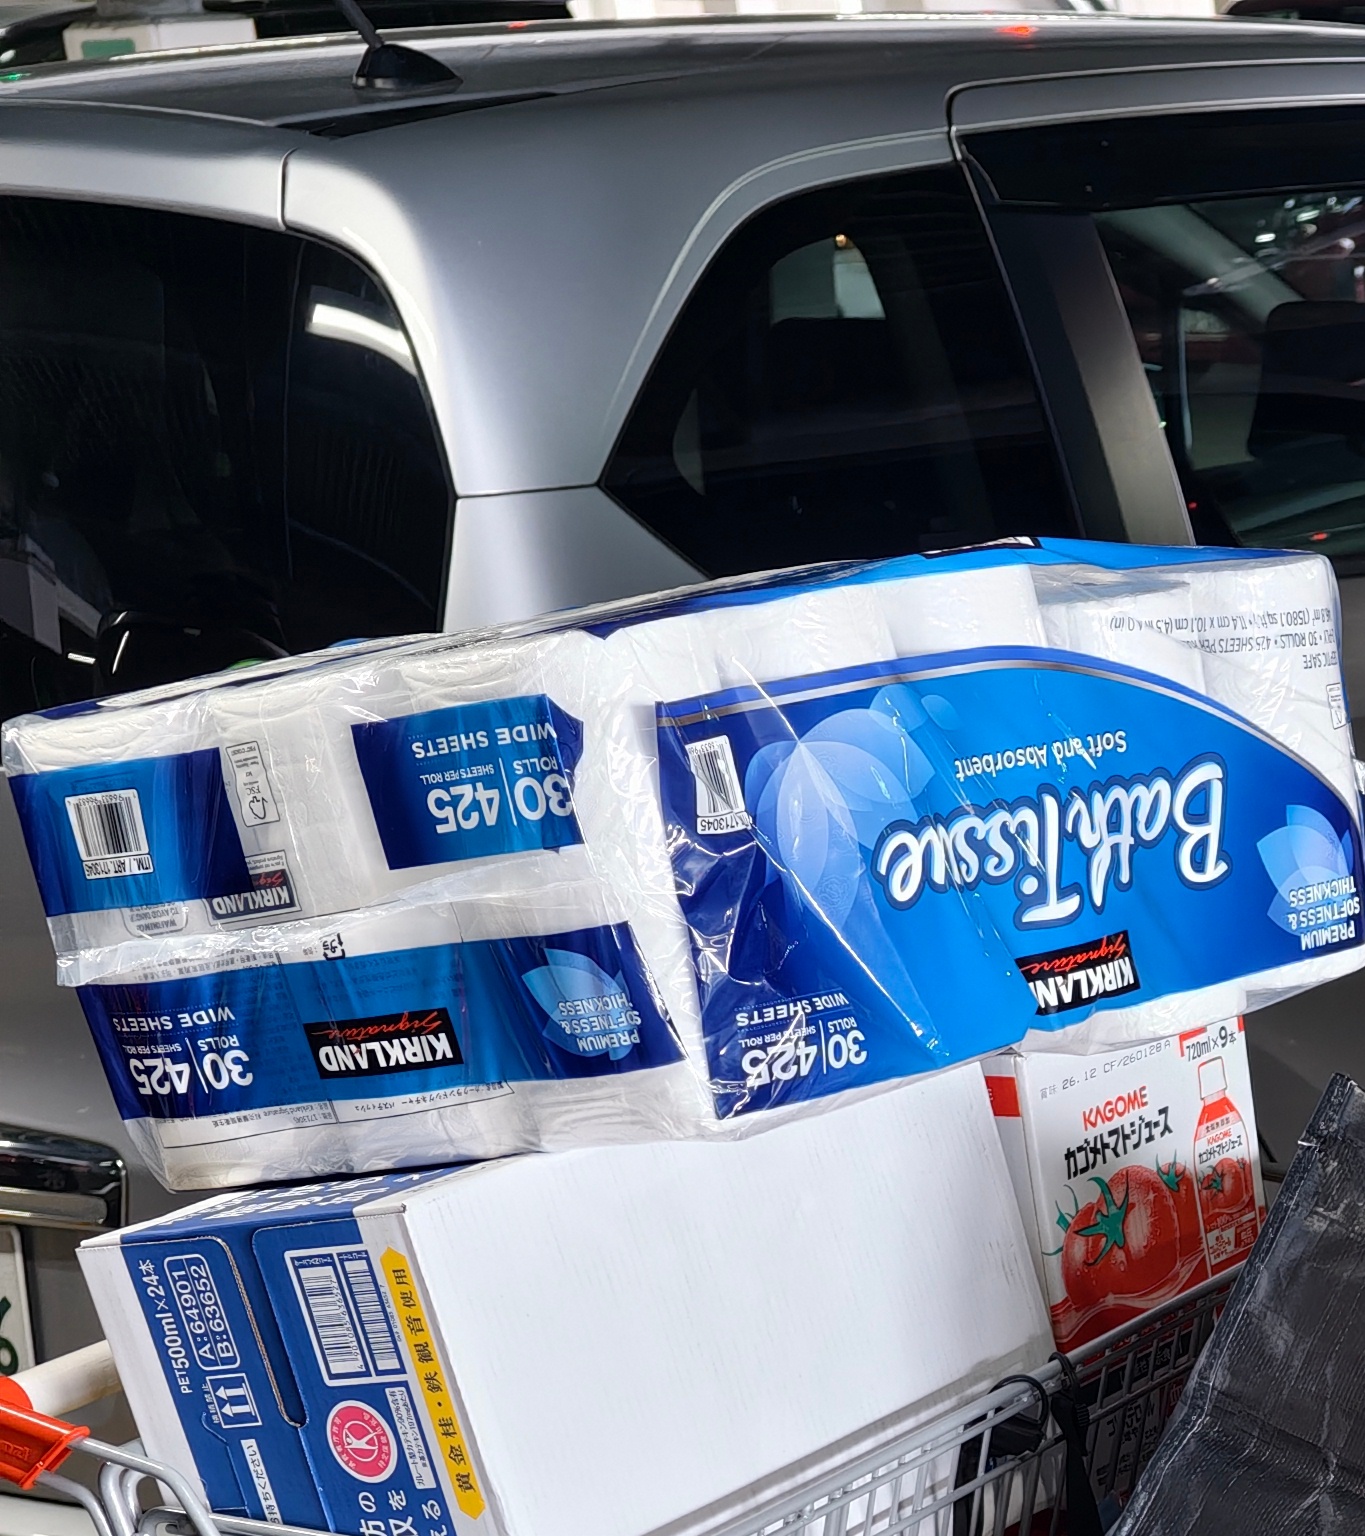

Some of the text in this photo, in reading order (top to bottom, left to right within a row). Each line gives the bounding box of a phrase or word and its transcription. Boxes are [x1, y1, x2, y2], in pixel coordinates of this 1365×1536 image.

[1174, 616, 1189, 631] cm
[1189, 616, 1207, 633] 10.1
[1307, 631, 1317, 645] 30
[1217, 635, 1254, 653] SHEETS
[1254, 634, 1272, 649] 425
[1279, 631, 1306, 648] ROLLS
[1301, 652, 1322, 668] SAFE
[410, 719, 556, 759] WIDE SHEETS
[418, 754, 558, 785] ROLLS SHEETS PER ROLL
[952, 728, 1129, 782] Soft and Absorbent
[425, 771, 572, 835] 30 425
[881, 761, 1226, 926] Bath Tissue
[211, 885, 289, 913] KIRKLAND
[1285, 874, 1358, 909] THICKNESS
[1285, 894, 1362, 930] SOFTNESS &
[1297, 921, 1358, 950] PREMIUM
[1016, 933, 1127, 978] Signature
[111, 1005, 235, 1034] WIDE SHEETS
[733, 991, 849, 1027] WIDE SHEETS
[826, 1015, 857, 1032] ROLLS
[309, 1007, 443, 1046] Signature
[559, 1018, 570, 1035] &
[575, 1027, 639, 1052] PREMIUM
[737, 1035, 763, 1047] ROLL
[763, 1031, 782, 1042] PER
[196, 1033, 239, 1051] ROLLS
[316, 1028, 452, 1076] KIRKLAND
[738, 1027, 868, 1087] 30 425
[128, 1047, 254, 1099] 30 425
[1080, 1085, 1150, 1131] KAGOME
[1061, 1105, 1174, 1180] カゴメトマトジュース
[1205, 1128, 1232, 1147] KAGOME
[391, 1266, 476, 1495] 黄金桂・鉄観音使用
